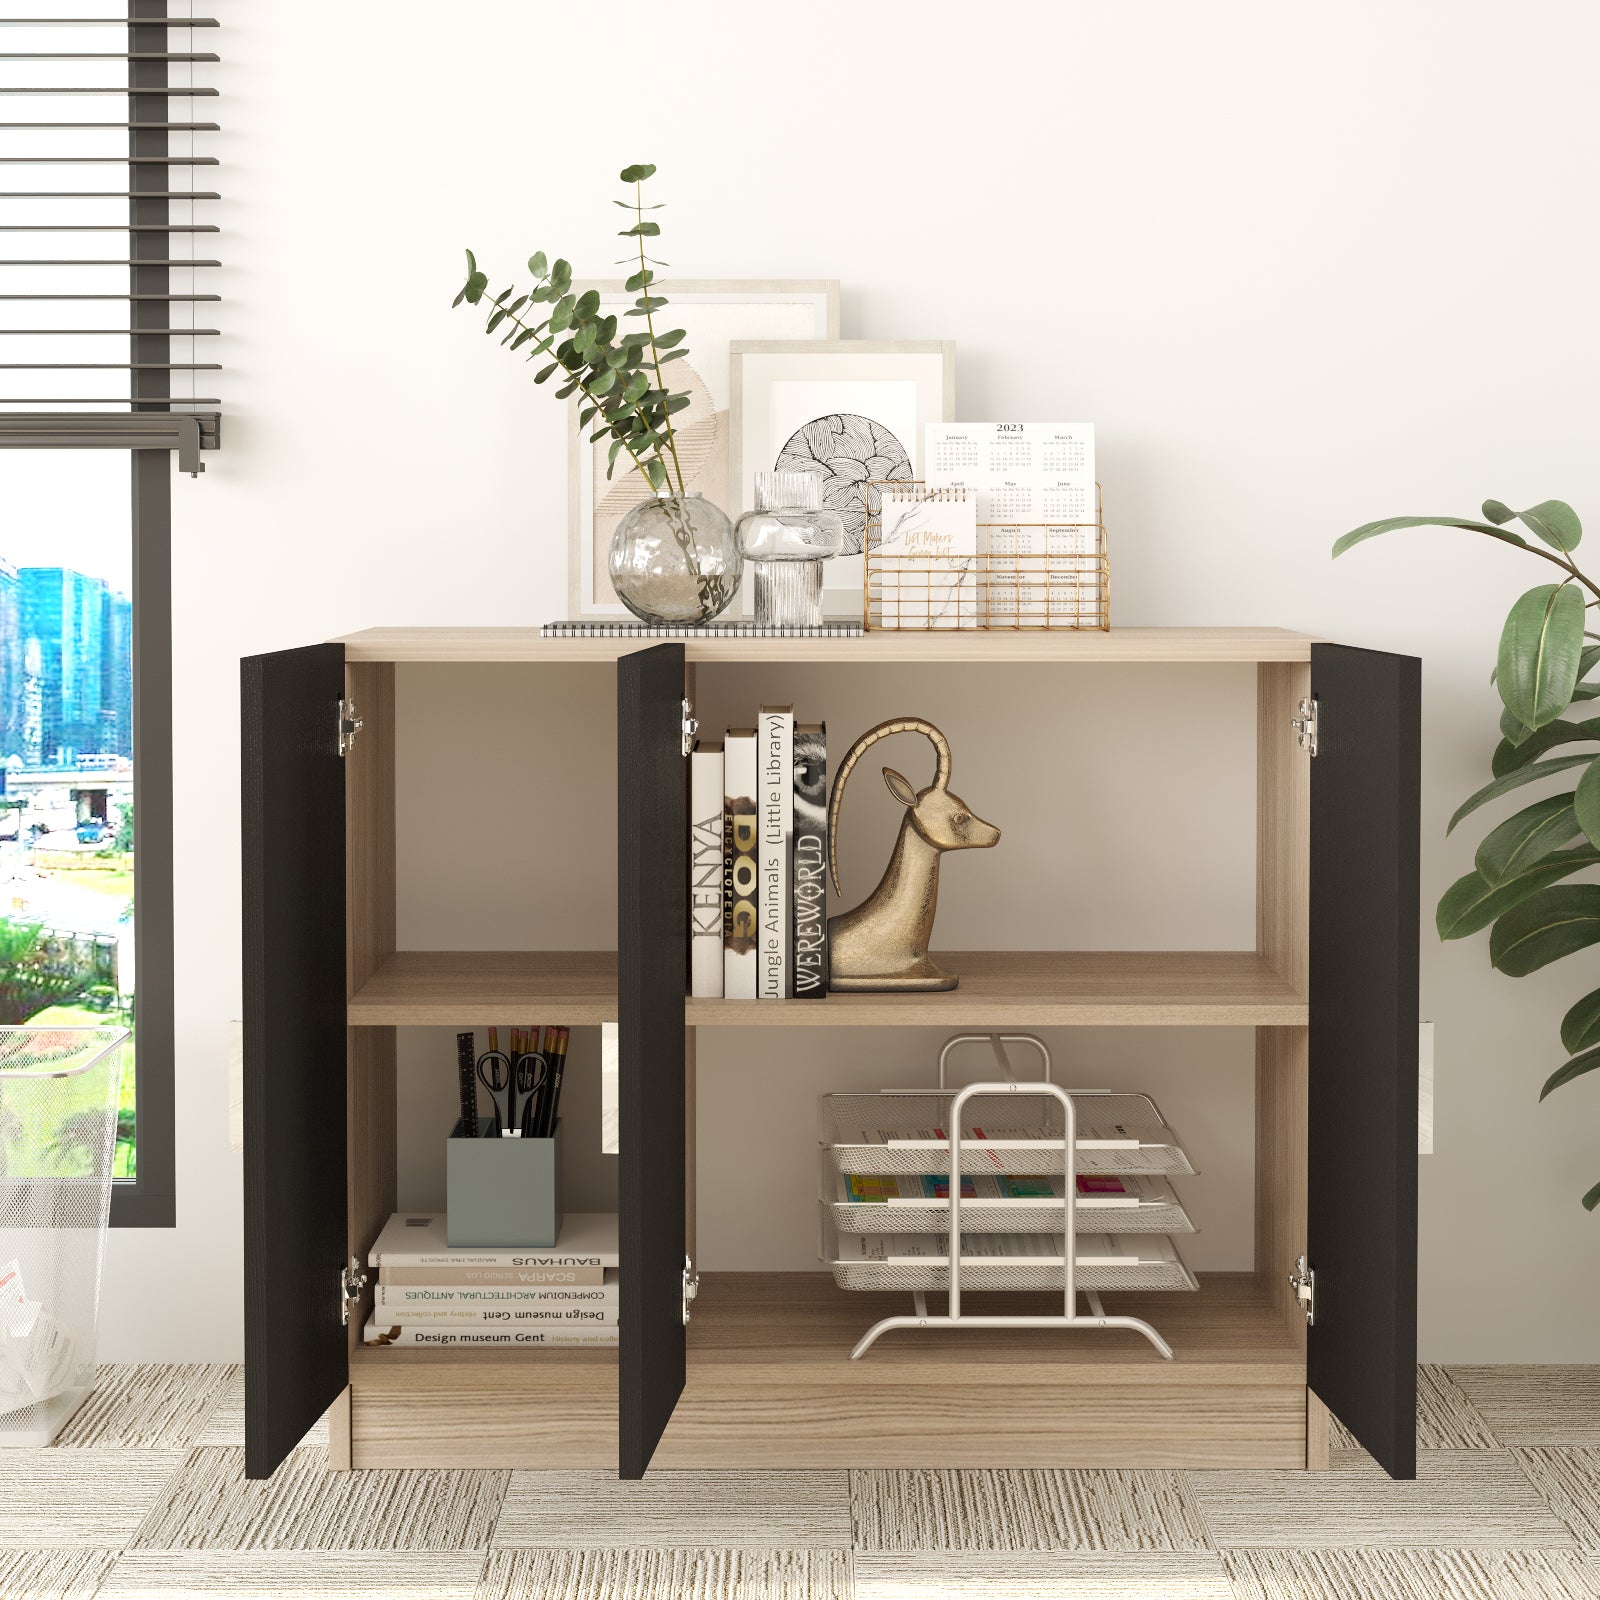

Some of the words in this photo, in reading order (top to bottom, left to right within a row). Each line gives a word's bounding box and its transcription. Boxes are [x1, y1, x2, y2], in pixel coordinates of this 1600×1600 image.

[996, 424, 1024, 432] 2023
[766, 715, 785, 785] Library)
[766, 792, 784, 845] (Little
[692, 810, 722, 940] KENYA
[724, 814, 733, 938] ENCYCLOPEDIA
[733, 814, 757, 938] DOG
[764, 858, 779, 933] Animals
[794, 835, 826, 992] WEREWORLD
[764, 939, 782, 998] Jungle
[512, 1257, 601, 1266] BAUHAUS
[518, 1272, 576, 1282] SCARPA
[405, 1291, 454, 1300] ANTIQUES
[458, 1291, 536, 1300] ARCHITECTURAL
[538, 1291, 605, 1300] COMPENDIUM
[482, 1311, 511, 1320] Gent
[514, 1311, 562, 1319] museum
[565, 1309, 604, 1320] Design
[415, 1333, 457, 1344] Design
[460, 1334, 511, 1342] museum
[515, 1333, 545, 1342] Gent
